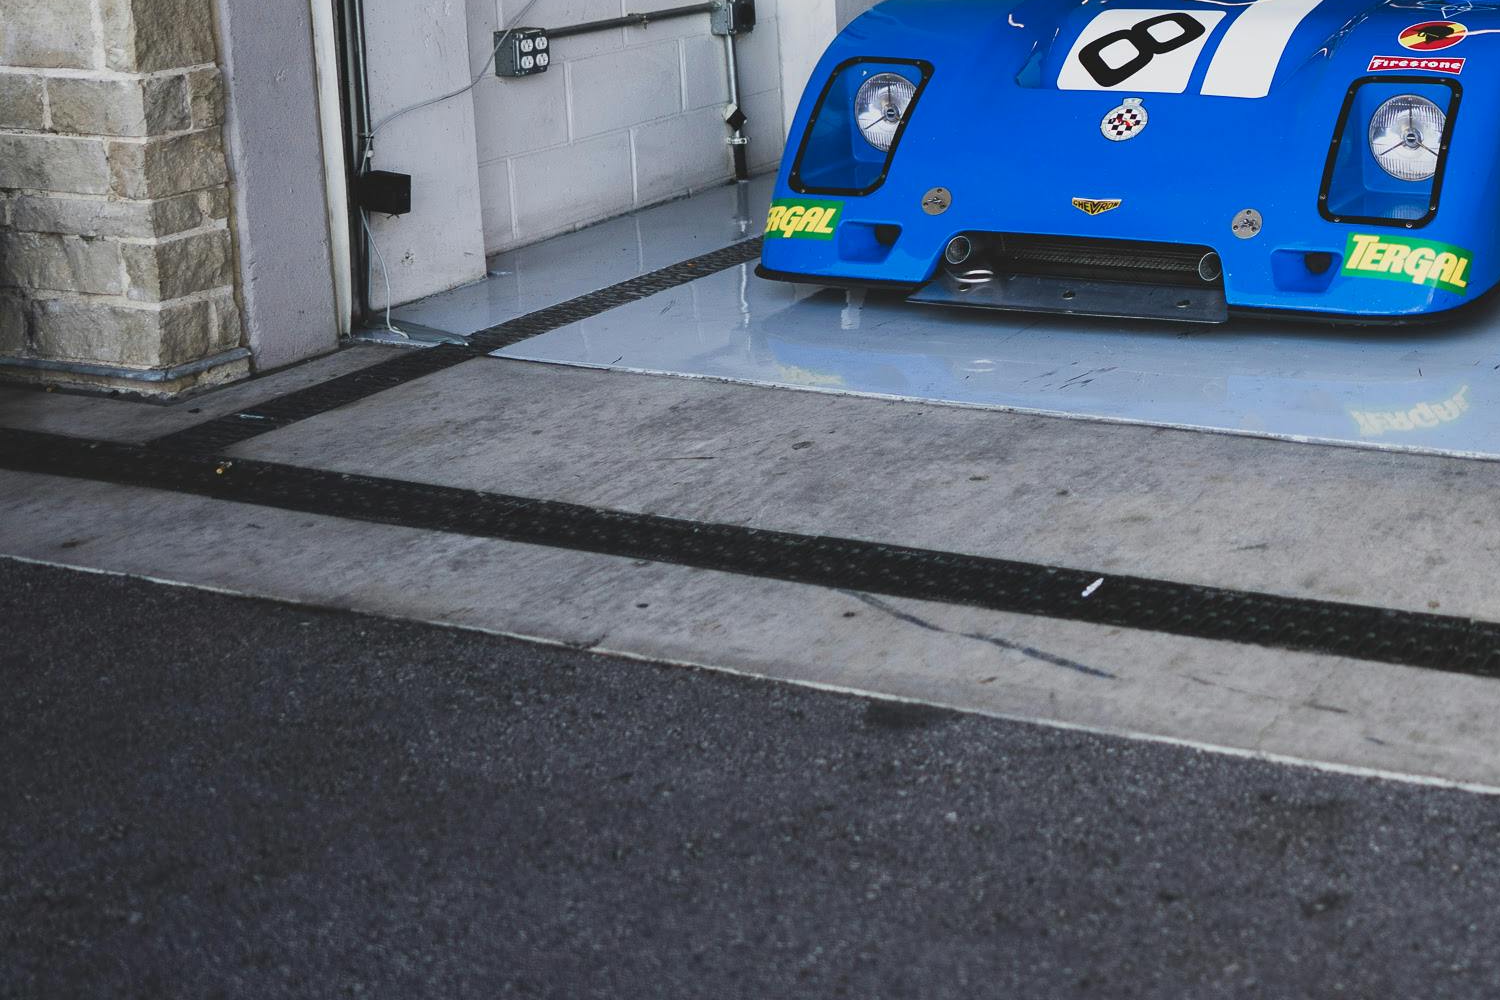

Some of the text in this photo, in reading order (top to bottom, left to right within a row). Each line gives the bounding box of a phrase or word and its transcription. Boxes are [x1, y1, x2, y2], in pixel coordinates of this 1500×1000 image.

[1078, 12, 1206, 88] 8
[1372, 58, 1462, 71] Firestone
[765, 205, 837, 238] RGAL
[1072, 199, 1121, 215] CHEVRON
[1345, 234, 1469, 288] TERGAL
